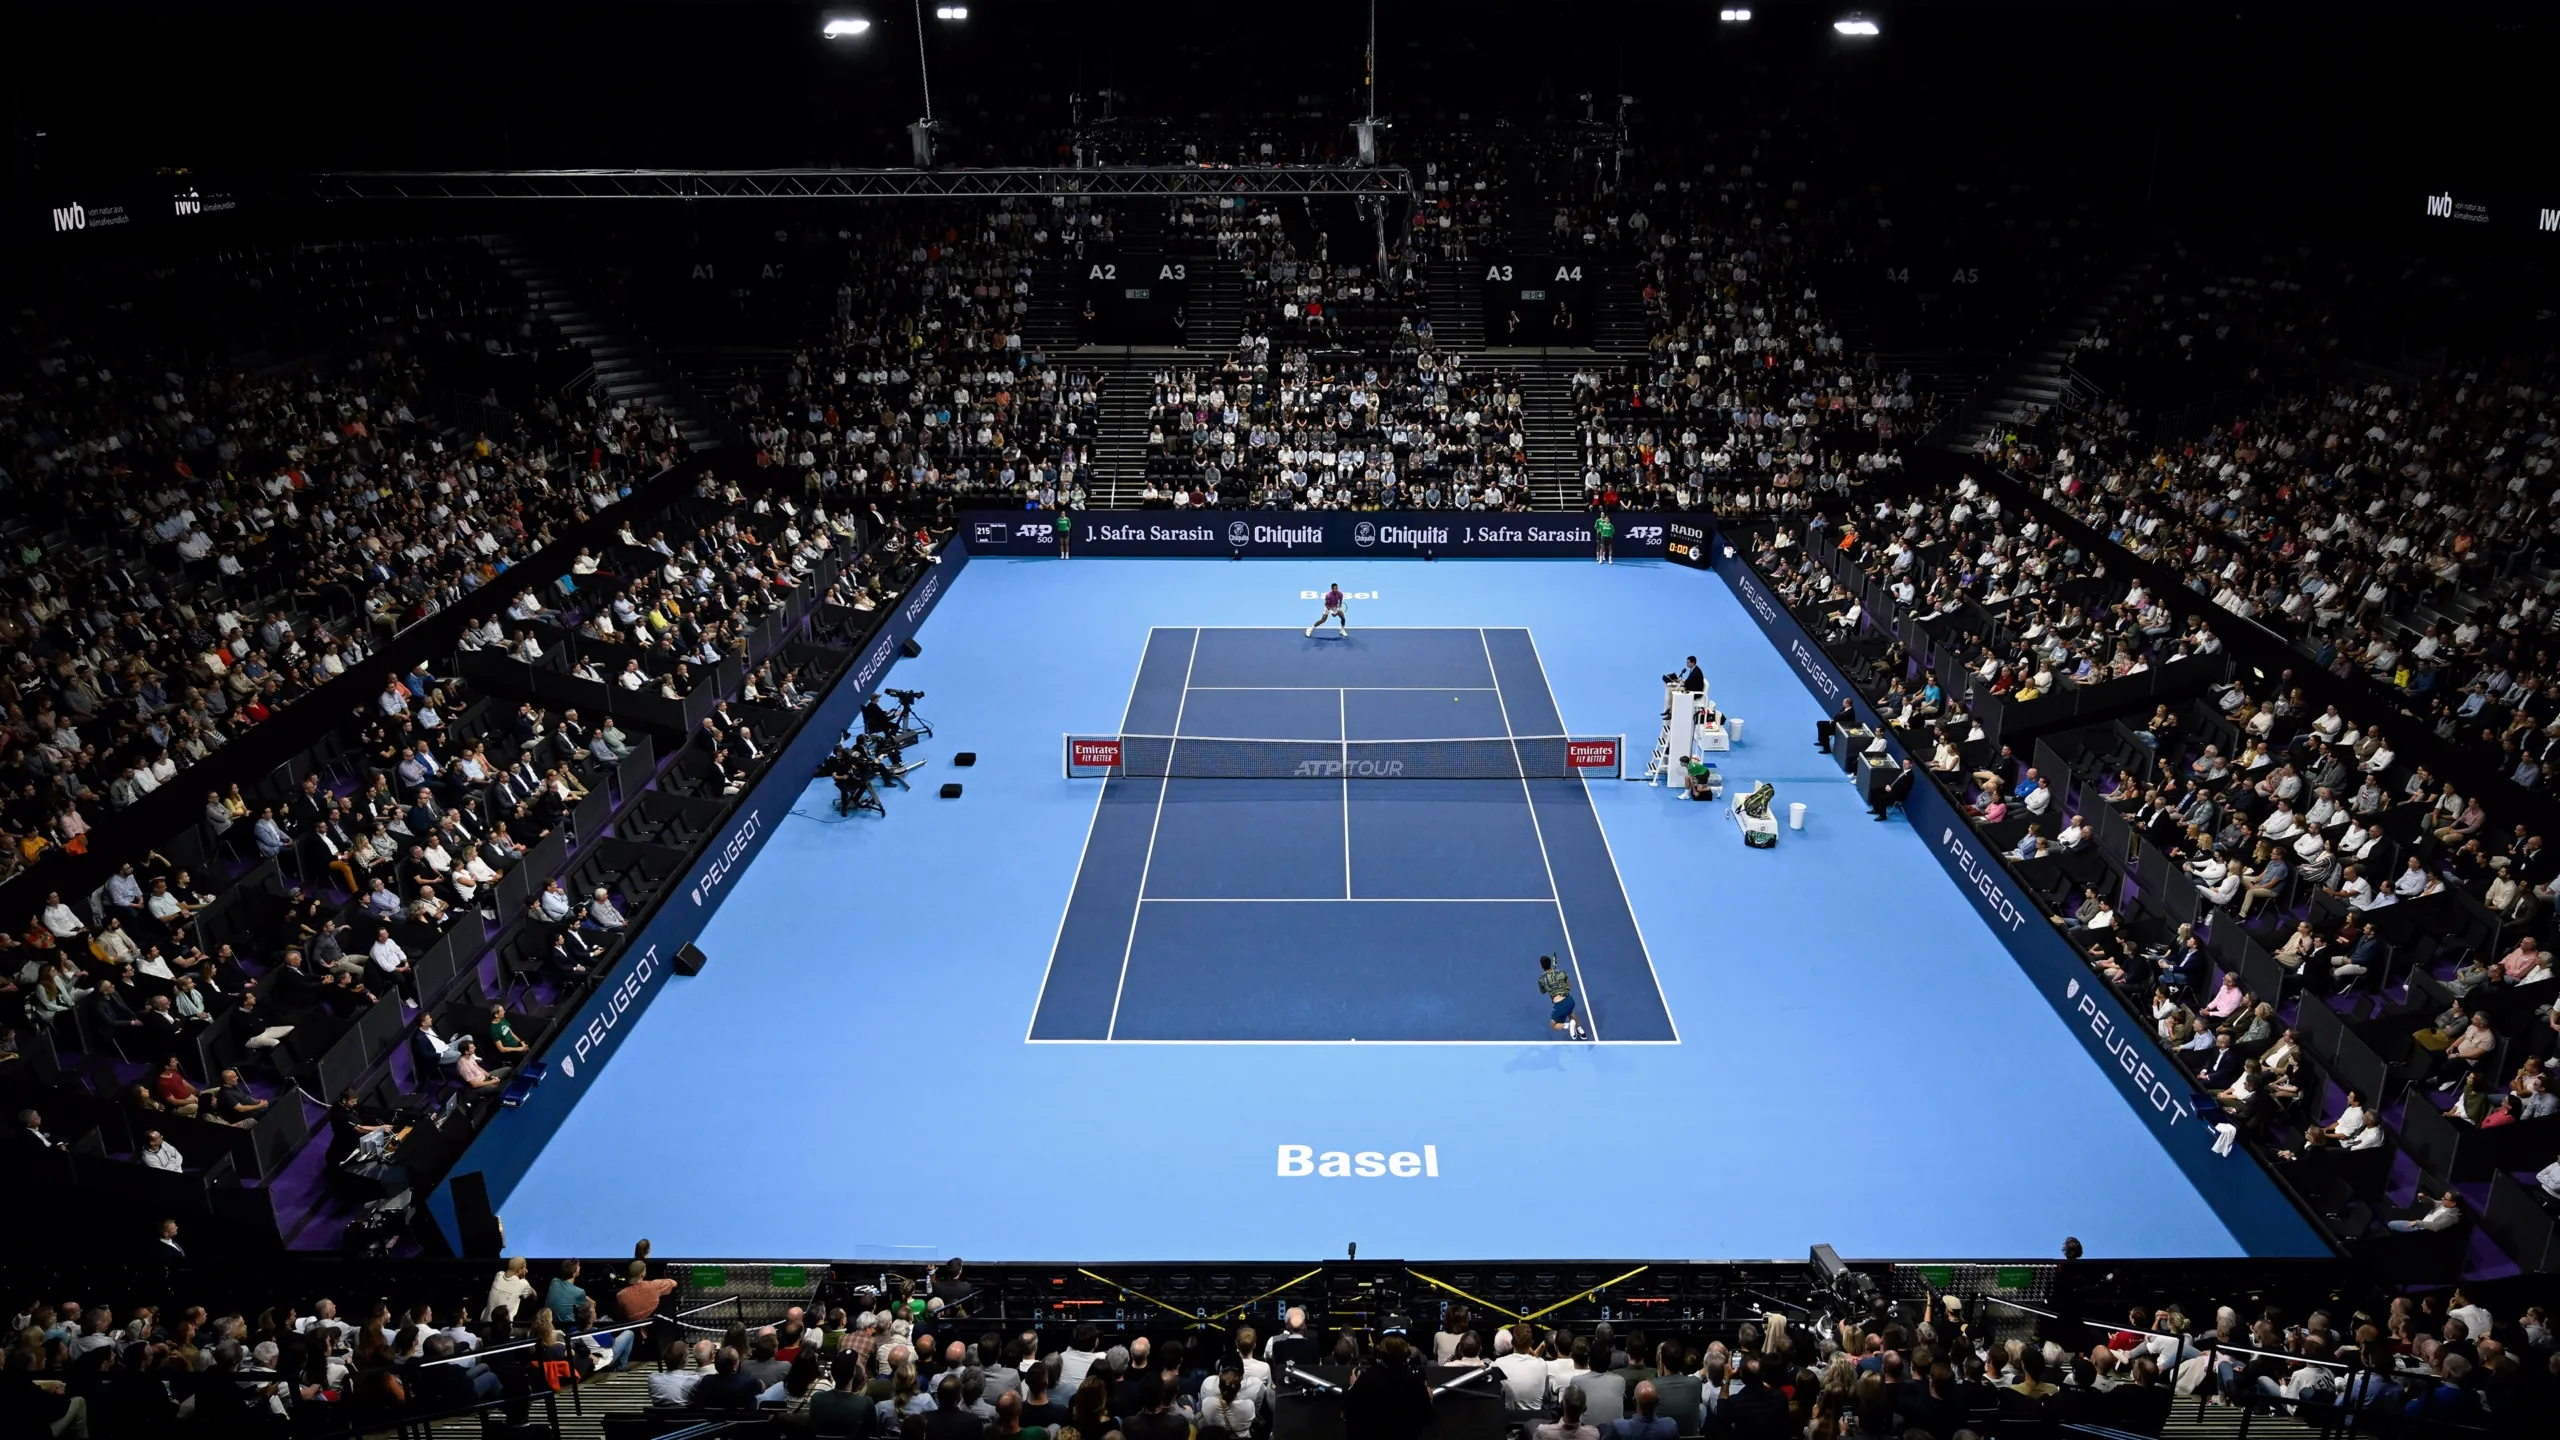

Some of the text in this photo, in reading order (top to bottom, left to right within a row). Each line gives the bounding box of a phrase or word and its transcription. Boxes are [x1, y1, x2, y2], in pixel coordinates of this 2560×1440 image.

[691, 263, 714, 280] A1
[1089, 264, 1116, 280] A2
[1159, 264, 1186, 280] A3
[1486, 265, 1513, 281] A3
[1555, 266, 1582, 281] A4
[1951, 267, 1979, 284] A5
[976, 527, 991, 535] 215
[1014, 524, 1053, 537] ATP
[1085, 524, 1215, 543] J. Safra Sarasin
[1254, 525, 1323, 549] Chiquita
[1380, 525, 1449, 549] Chiquita
[1462, 526, 1592, 544] J. Safra Sarasin
[1624, 526, 1663, 538] ATP
[1670, 523, 1703, 539] RADO
[1669, 542, 1688, 555] 0:00
[911, 574, 939, 616] PEUGEOT
[1743, 580, 1777, 625] PEUGEOT
[858, 634, 894, 688] PEUGEOT
[1796, 645, 1839, 700] PEUGEOT
[1075, 745, 1118, 754] Emirates
[1082, 754, 1113, 762] FLY BETTER
[1570, 746, 1613, 755] Emirates
[1576, 755, 1606, 763] FLY BETTER
[1291, 760, 1404, 776] ATP TOUR
[700, 809, 762, 897] PEUGEOT
[1950, 837, 2026, 932] PEUGEOT
[574, 944, 660, 1064] PEUGEOT
[2077, 993, 2188, 1127] PEUGEOT
[1277, 1144, 1439, 1177] Basel
